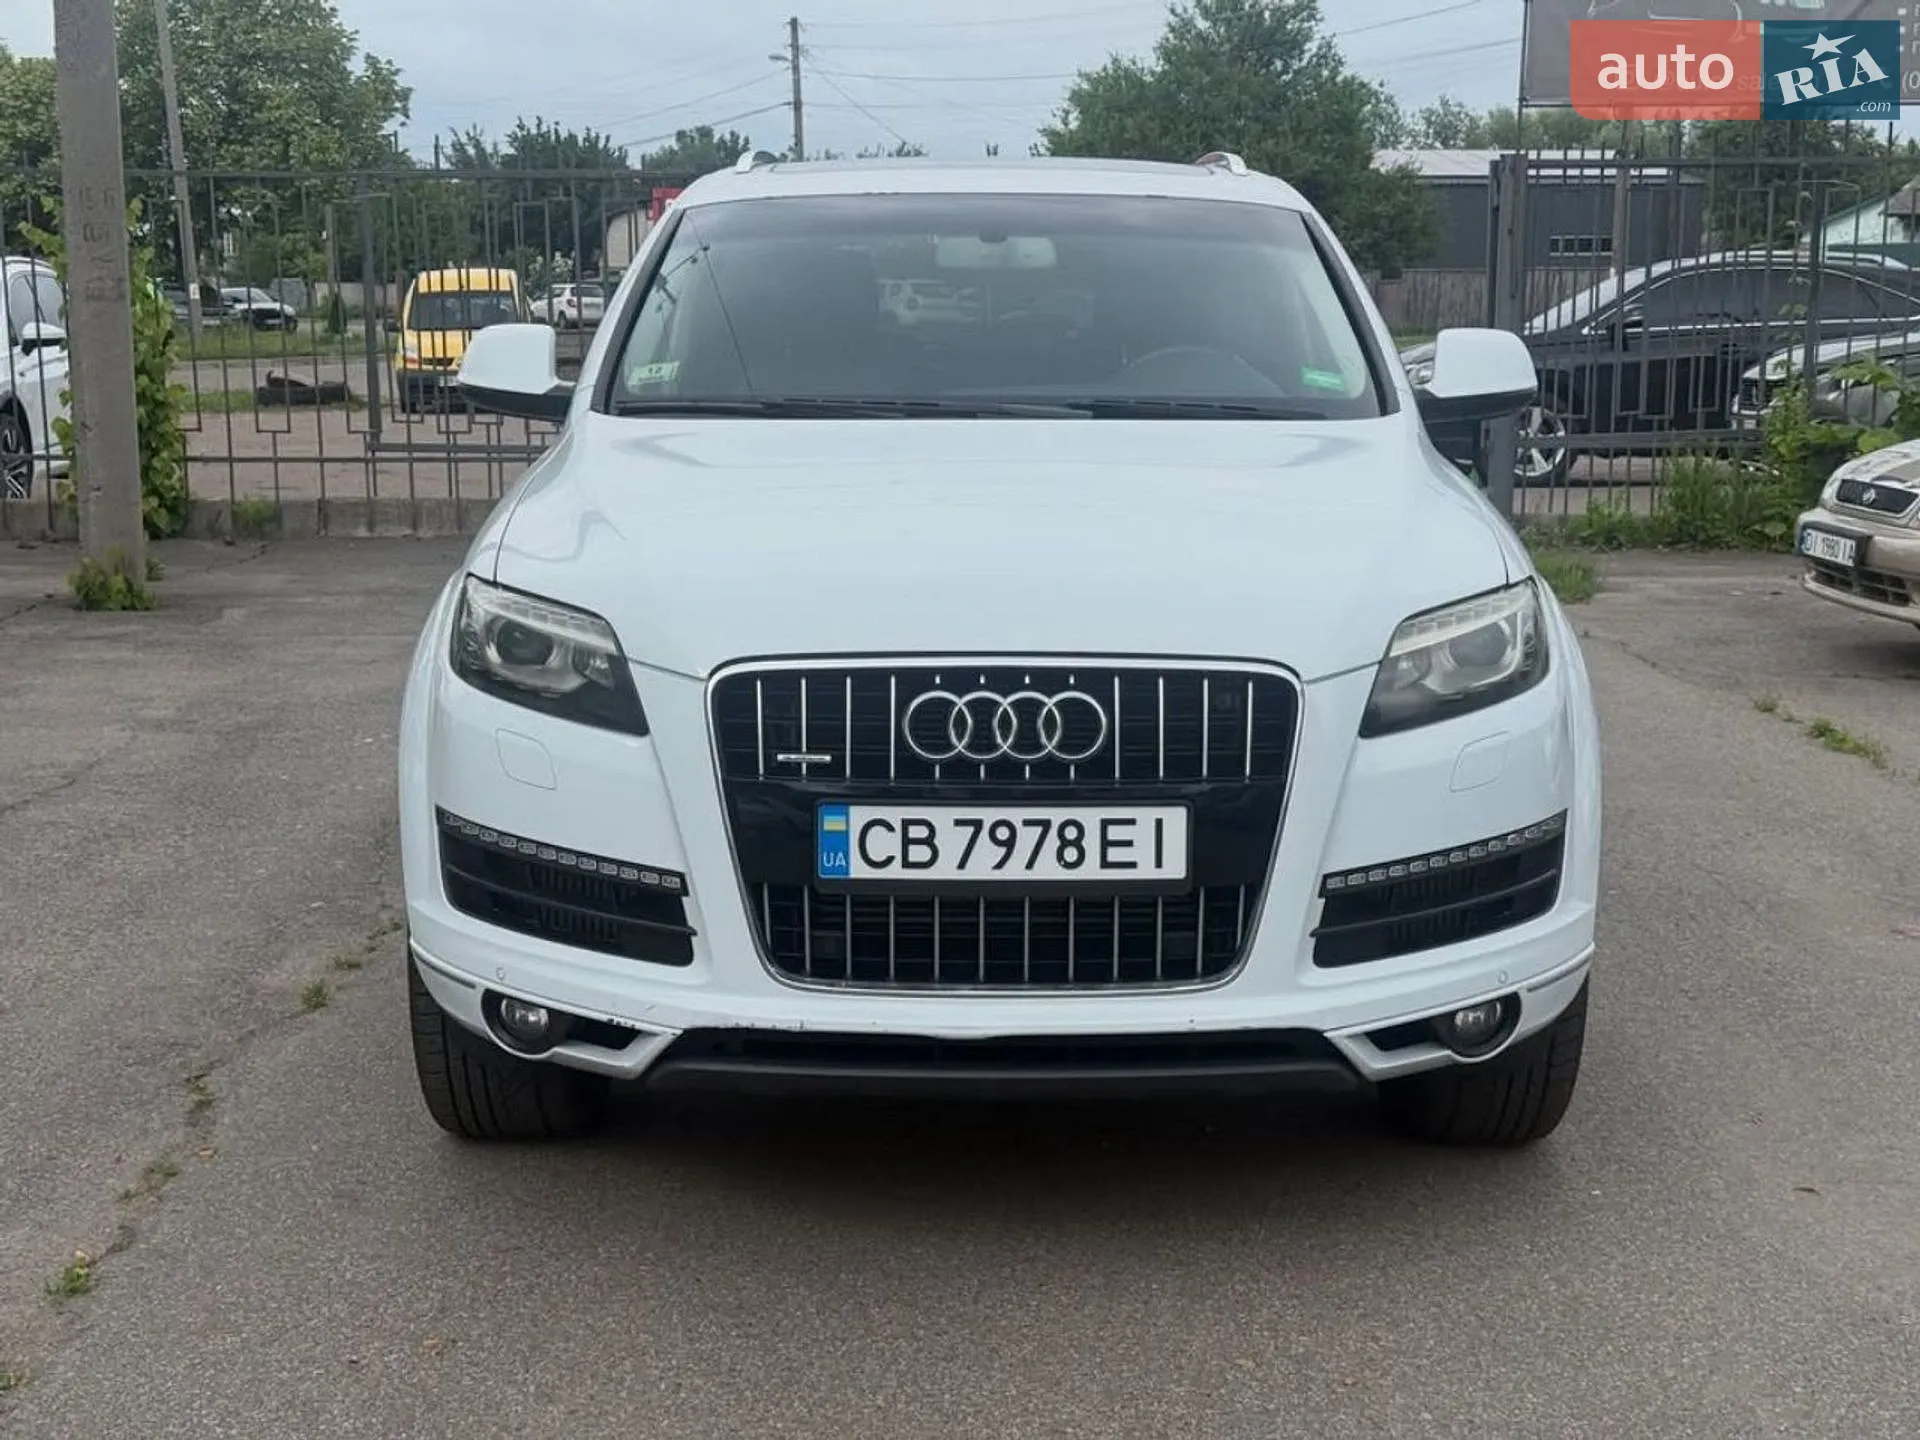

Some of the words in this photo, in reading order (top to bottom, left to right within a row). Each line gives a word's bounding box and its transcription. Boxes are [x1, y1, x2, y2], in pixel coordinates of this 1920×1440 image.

[823, 852, 848, 868] UA
[858, 817, 939, 870] CB
[952, 817, 1086, 870] 7978
[1099, 817, 1164, 870] EI
